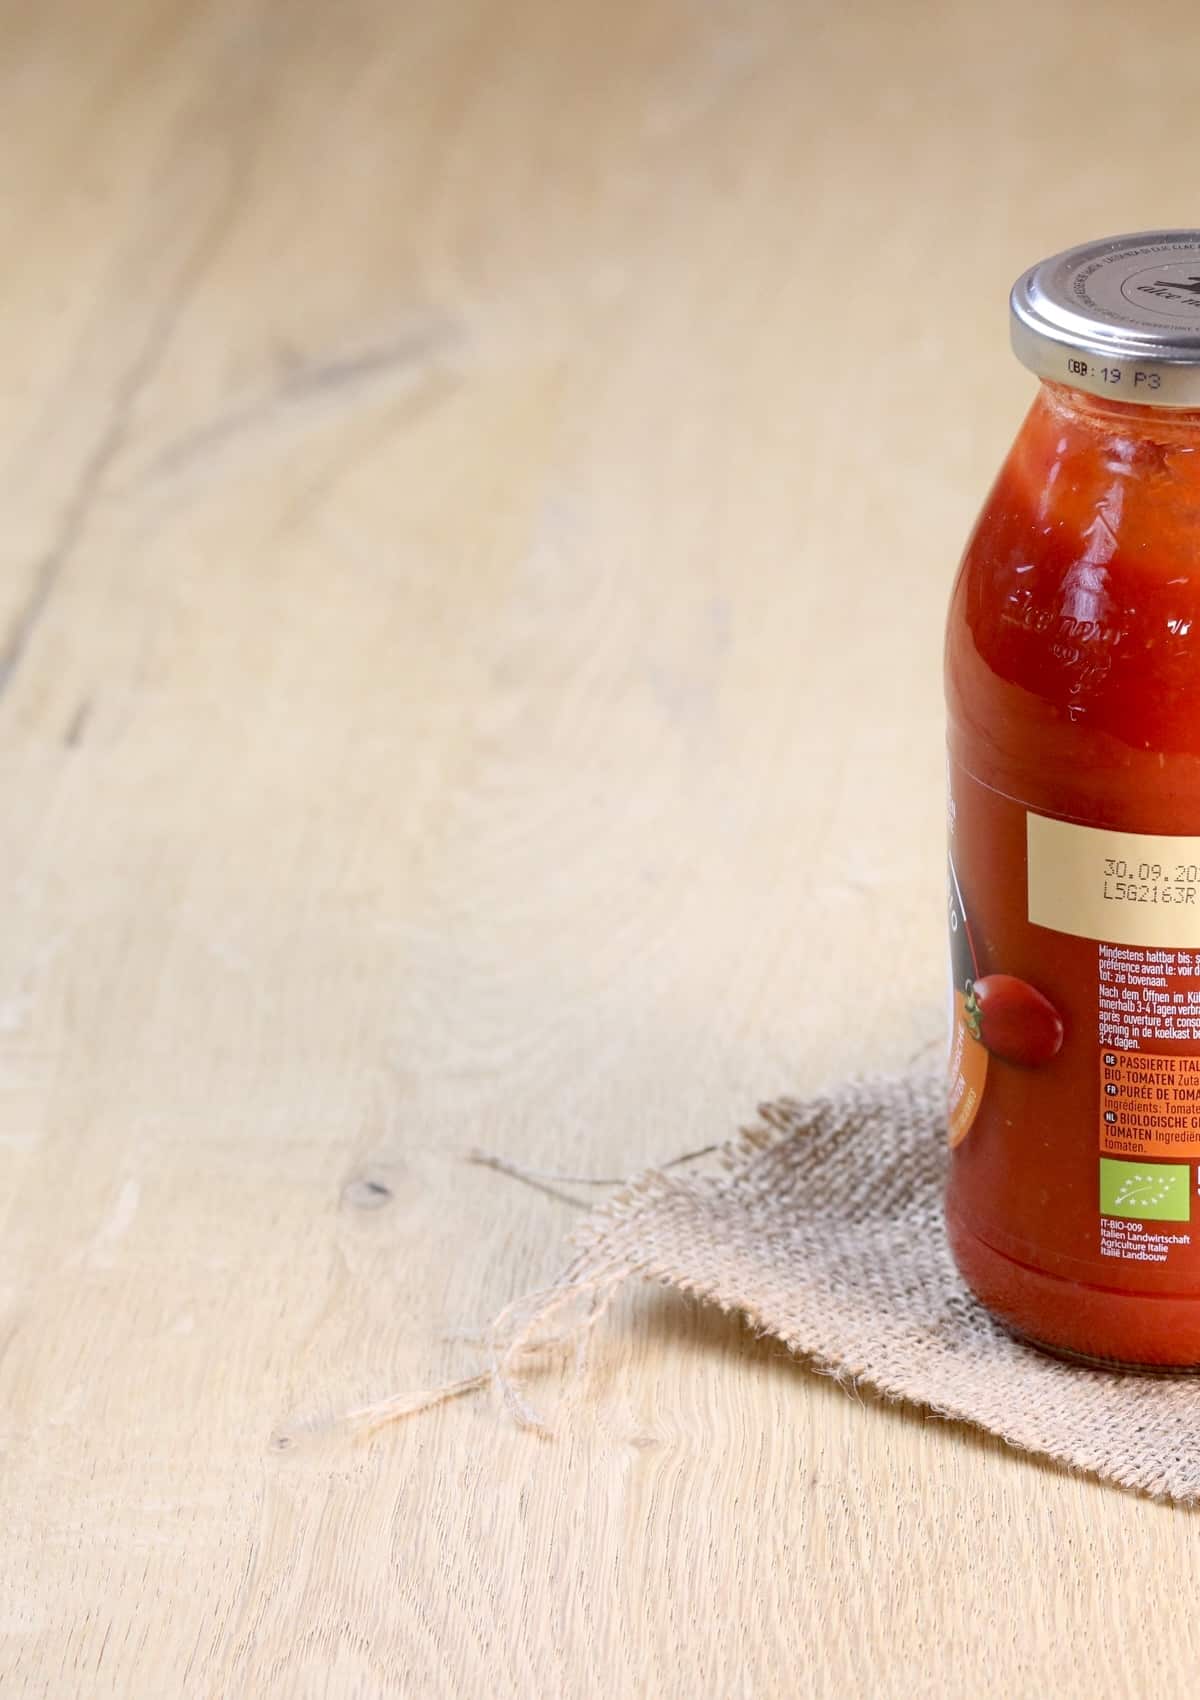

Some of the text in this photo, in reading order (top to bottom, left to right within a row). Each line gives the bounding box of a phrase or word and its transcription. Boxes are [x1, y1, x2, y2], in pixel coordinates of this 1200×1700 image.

[1134, 370, 1162, 391] P3
[1103, 880, 1197, 905] L5G2163R
[1099, 944, 1144, 962] Mindestens
[1147, 949, 1175, 963] haltbar
[1178, 951, 1193, 963] bis:
[1142, 963, 1163, 976] avant
[1166, 963, 1177, 976] le:
[1178, 963, 1193, 976] voir
[1115, 971, 1126, 984] zie
[1128, 972, 1168, 988] bovenaan.
[1099, 983, 1119, 998] Nach
[1122, 986, 1139, 1001] dem
[1143, 987, 1170, 1004] Öffnen
[1173, 990, 1184, 1004] im
[1099, 998, 1135, 1014] innerhalb
[1137, 1000, 1151, 1014] 3-4
[1152, 1001, 1177, 1018] Tagen
[1099, 1009, 1121, 1024] après
[1124, 1013, 1161, 1027] ouverture
[1165, 1015, 1173, 1027] et
[1099, 1021, 1130, 1039] opening
[1132, 1025, 1140, 1037] in
[1142, 1026, 1153, 1038] de
[1155, 1026, 1190, 1039] koelkast
[1099, 1033, 1141, 1050] 3-4 dagen.
[1106, 1055, 1117, 1066] DE
[1120, 1055, 1177, 1072] PASSIERTE
[1104, 1068, 1175, 1087] BIO-TOMATEN
[1106, 1085, 1117, 1096] FR
[1120, 1084, 1153, 1101] PURÉE
[1156, 1088, 1170, 1101] DE
[1106, 1112, 1117, 1123] NL
[1120, 1111, 1188, 1129] BIOLOGISCHE
[1104, 1124, 1152, 1142] TOMATEN
[1104, 1139, 1147, 1154] tomaten.
[1100, 1218, 1143, 1232] IT-BIO-009
[1100, 1228, 1191, 1246] Italien Landwirtschaft
[1100, 1238, 1169, 1254] Agriculture Italie
[1122, 1248, 1168, 1263] Landbouw
